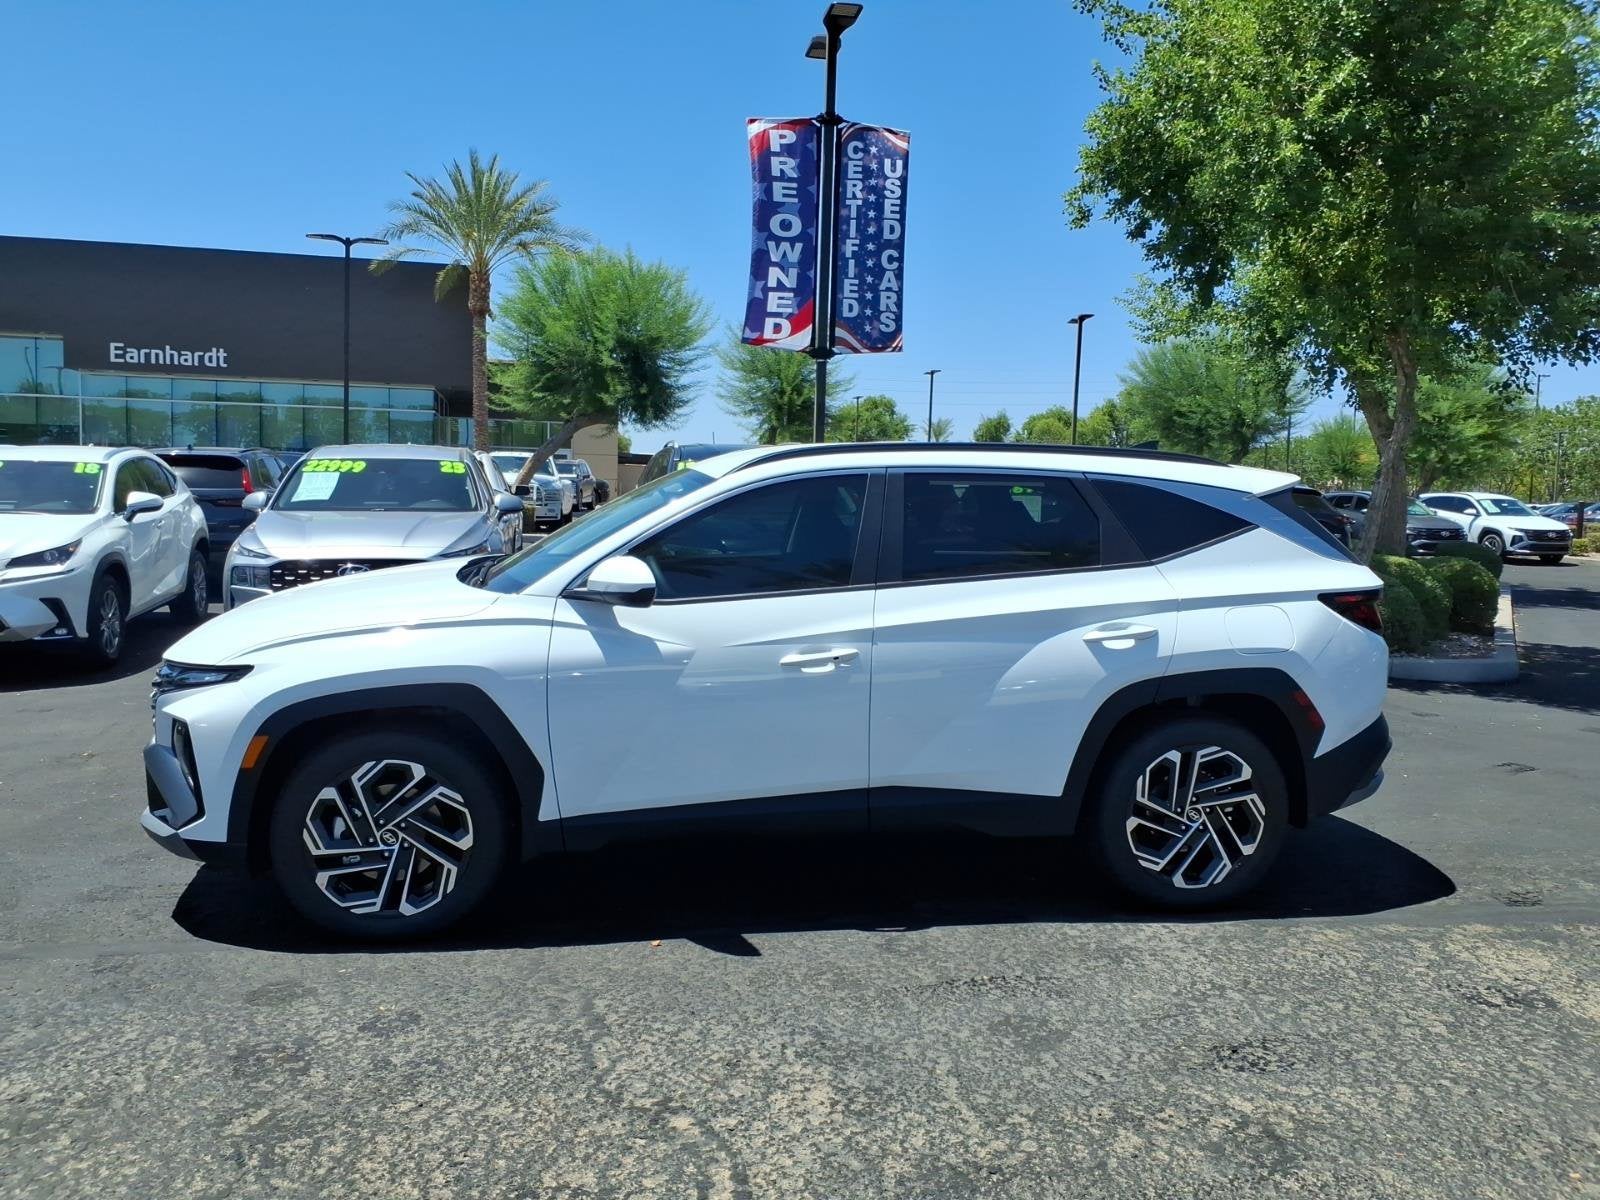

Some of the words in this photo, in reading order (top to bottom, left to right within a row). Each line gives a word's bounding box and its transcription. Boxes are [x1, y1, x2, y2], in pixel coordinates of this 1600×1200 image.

[882, 158, 903, 240] USED
[842, 140, 864, 318] CERTIFIED
[878, 249, 900, 333] CARS
[109, 342, 228, 368] Earnhardt
[74, 462, 100, 474] 18
[302, 459, 367, 473] 22999
